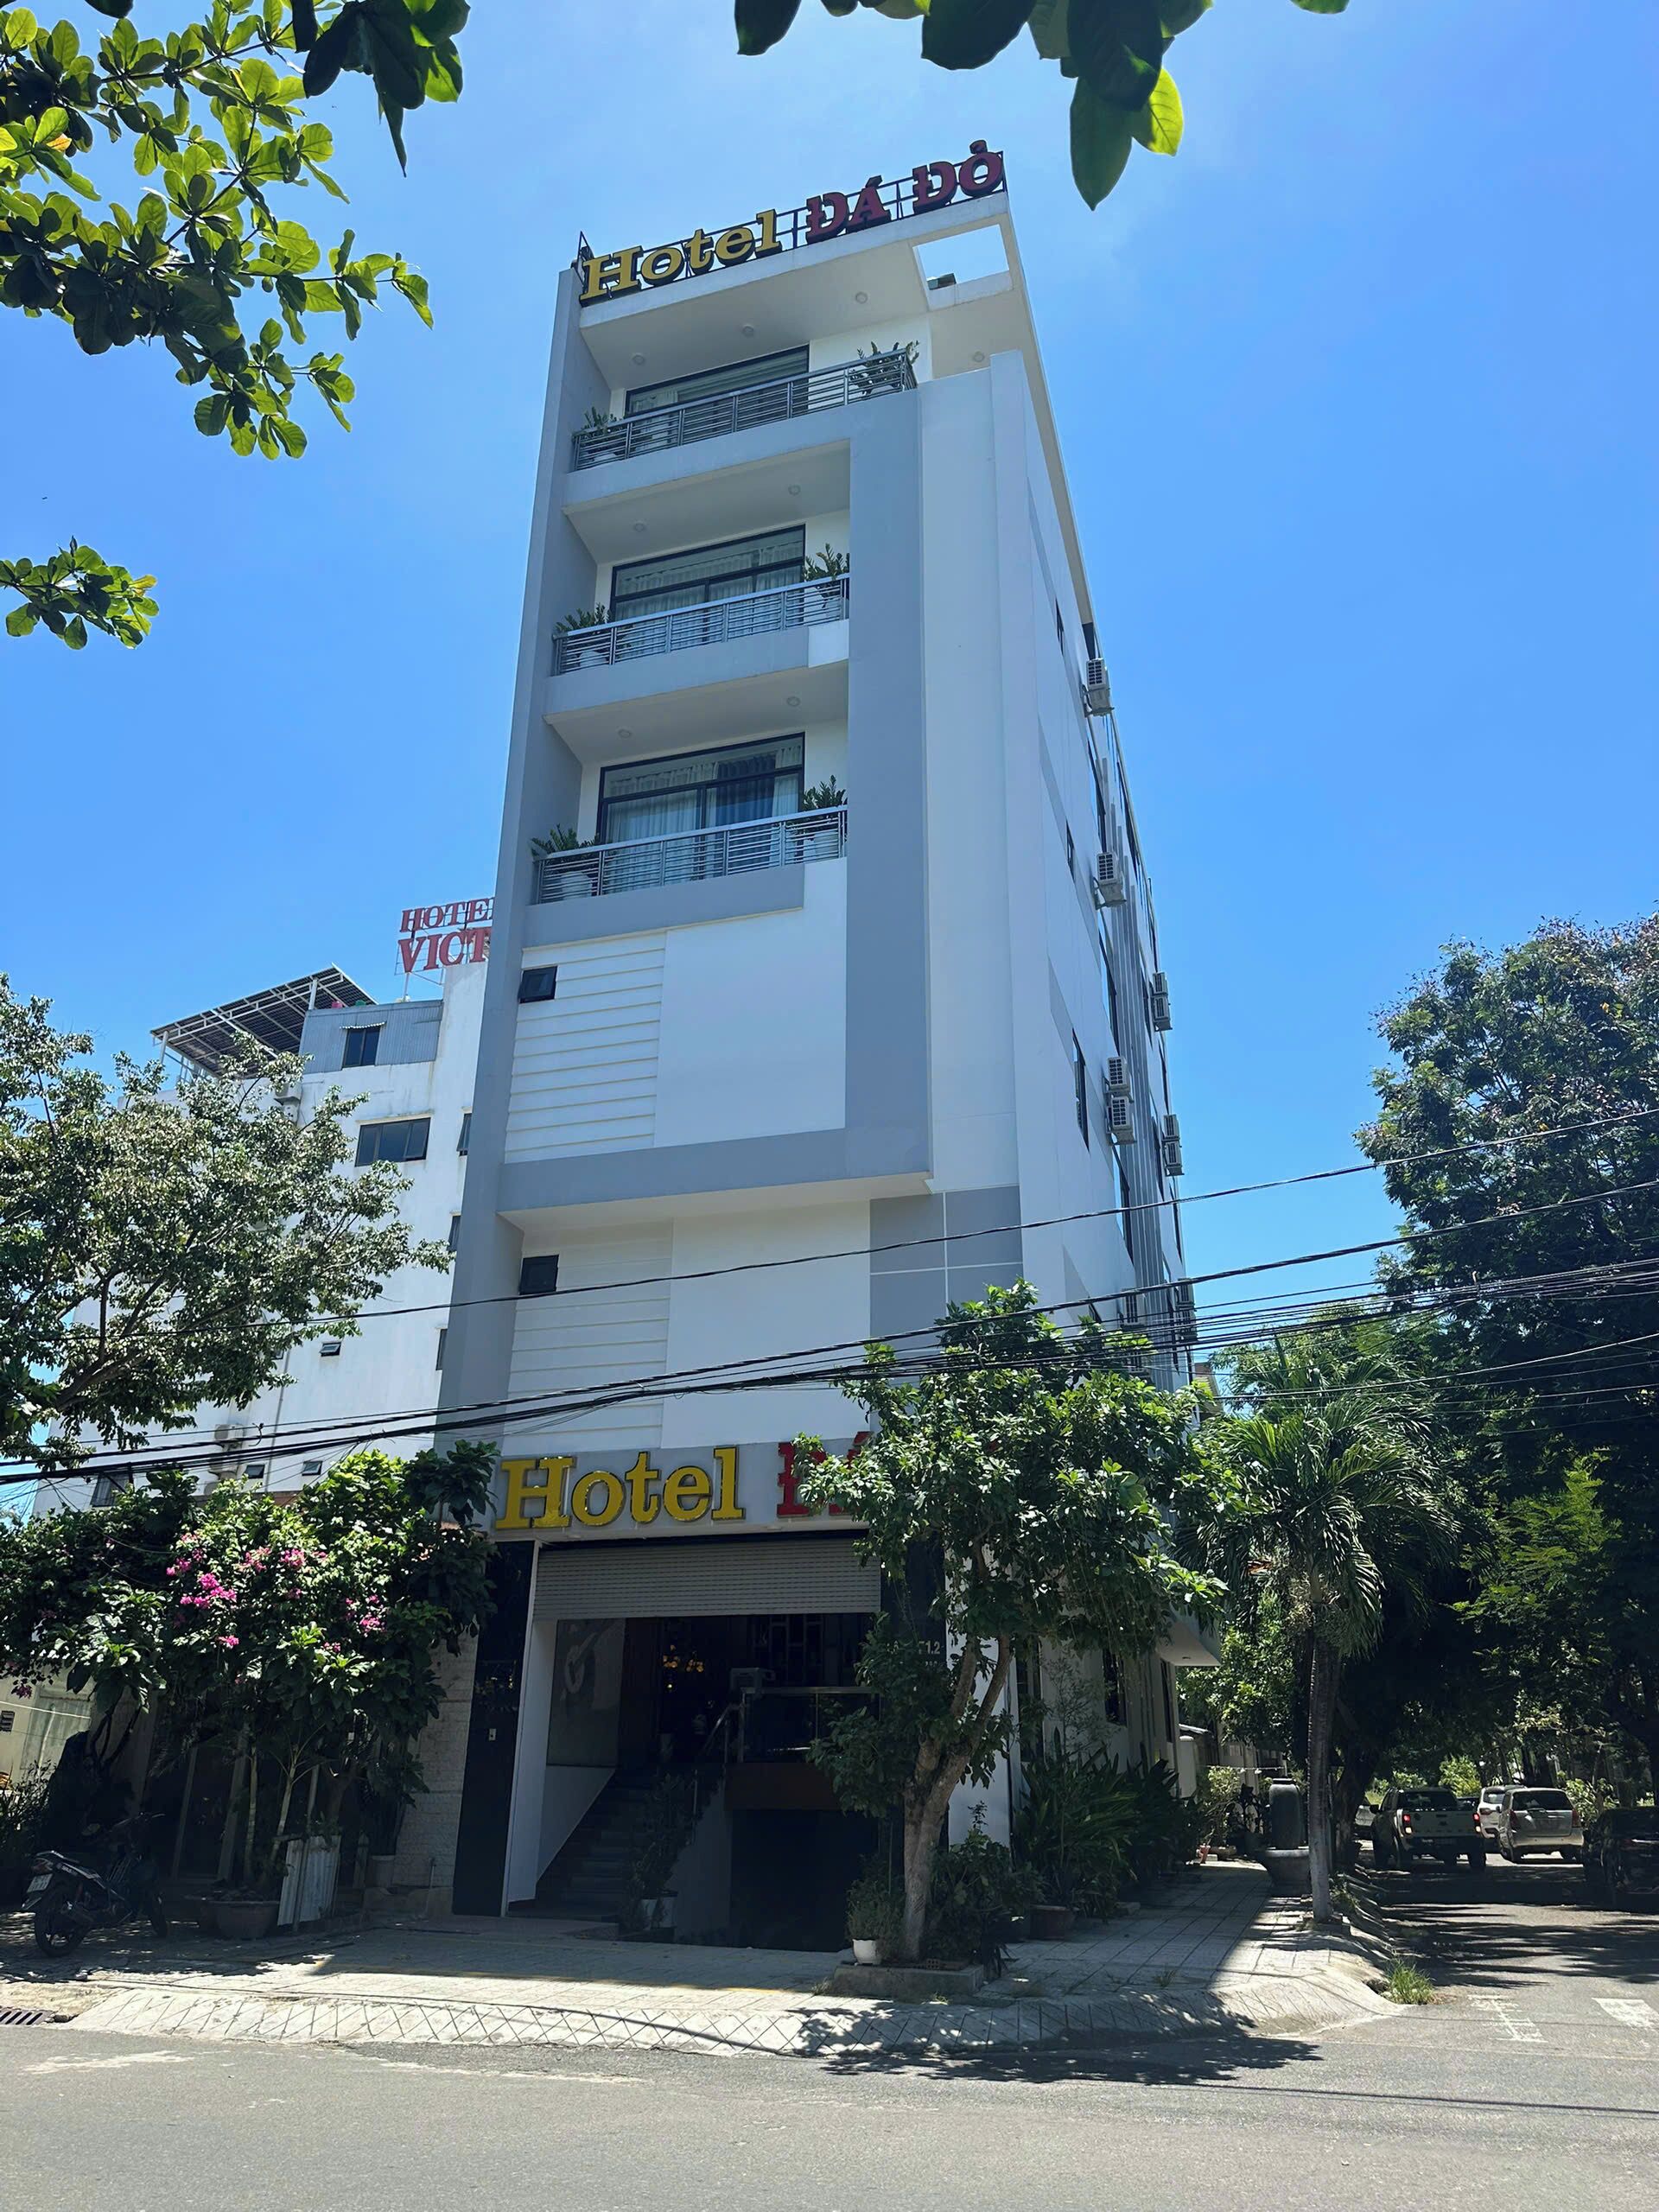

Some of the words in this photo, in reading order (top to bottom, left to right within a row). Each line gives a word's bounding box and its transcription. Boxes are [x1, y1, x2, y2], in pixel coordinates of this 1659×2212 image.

[580, 209, 782, 307] Hotel
[805, 175, 891, 245] ĐÁ
[912, 140, 1003, 213] ĐỎ
[399, 898, 493, 932] HOTE
[495, 1446, 745, 1529] Hotel
